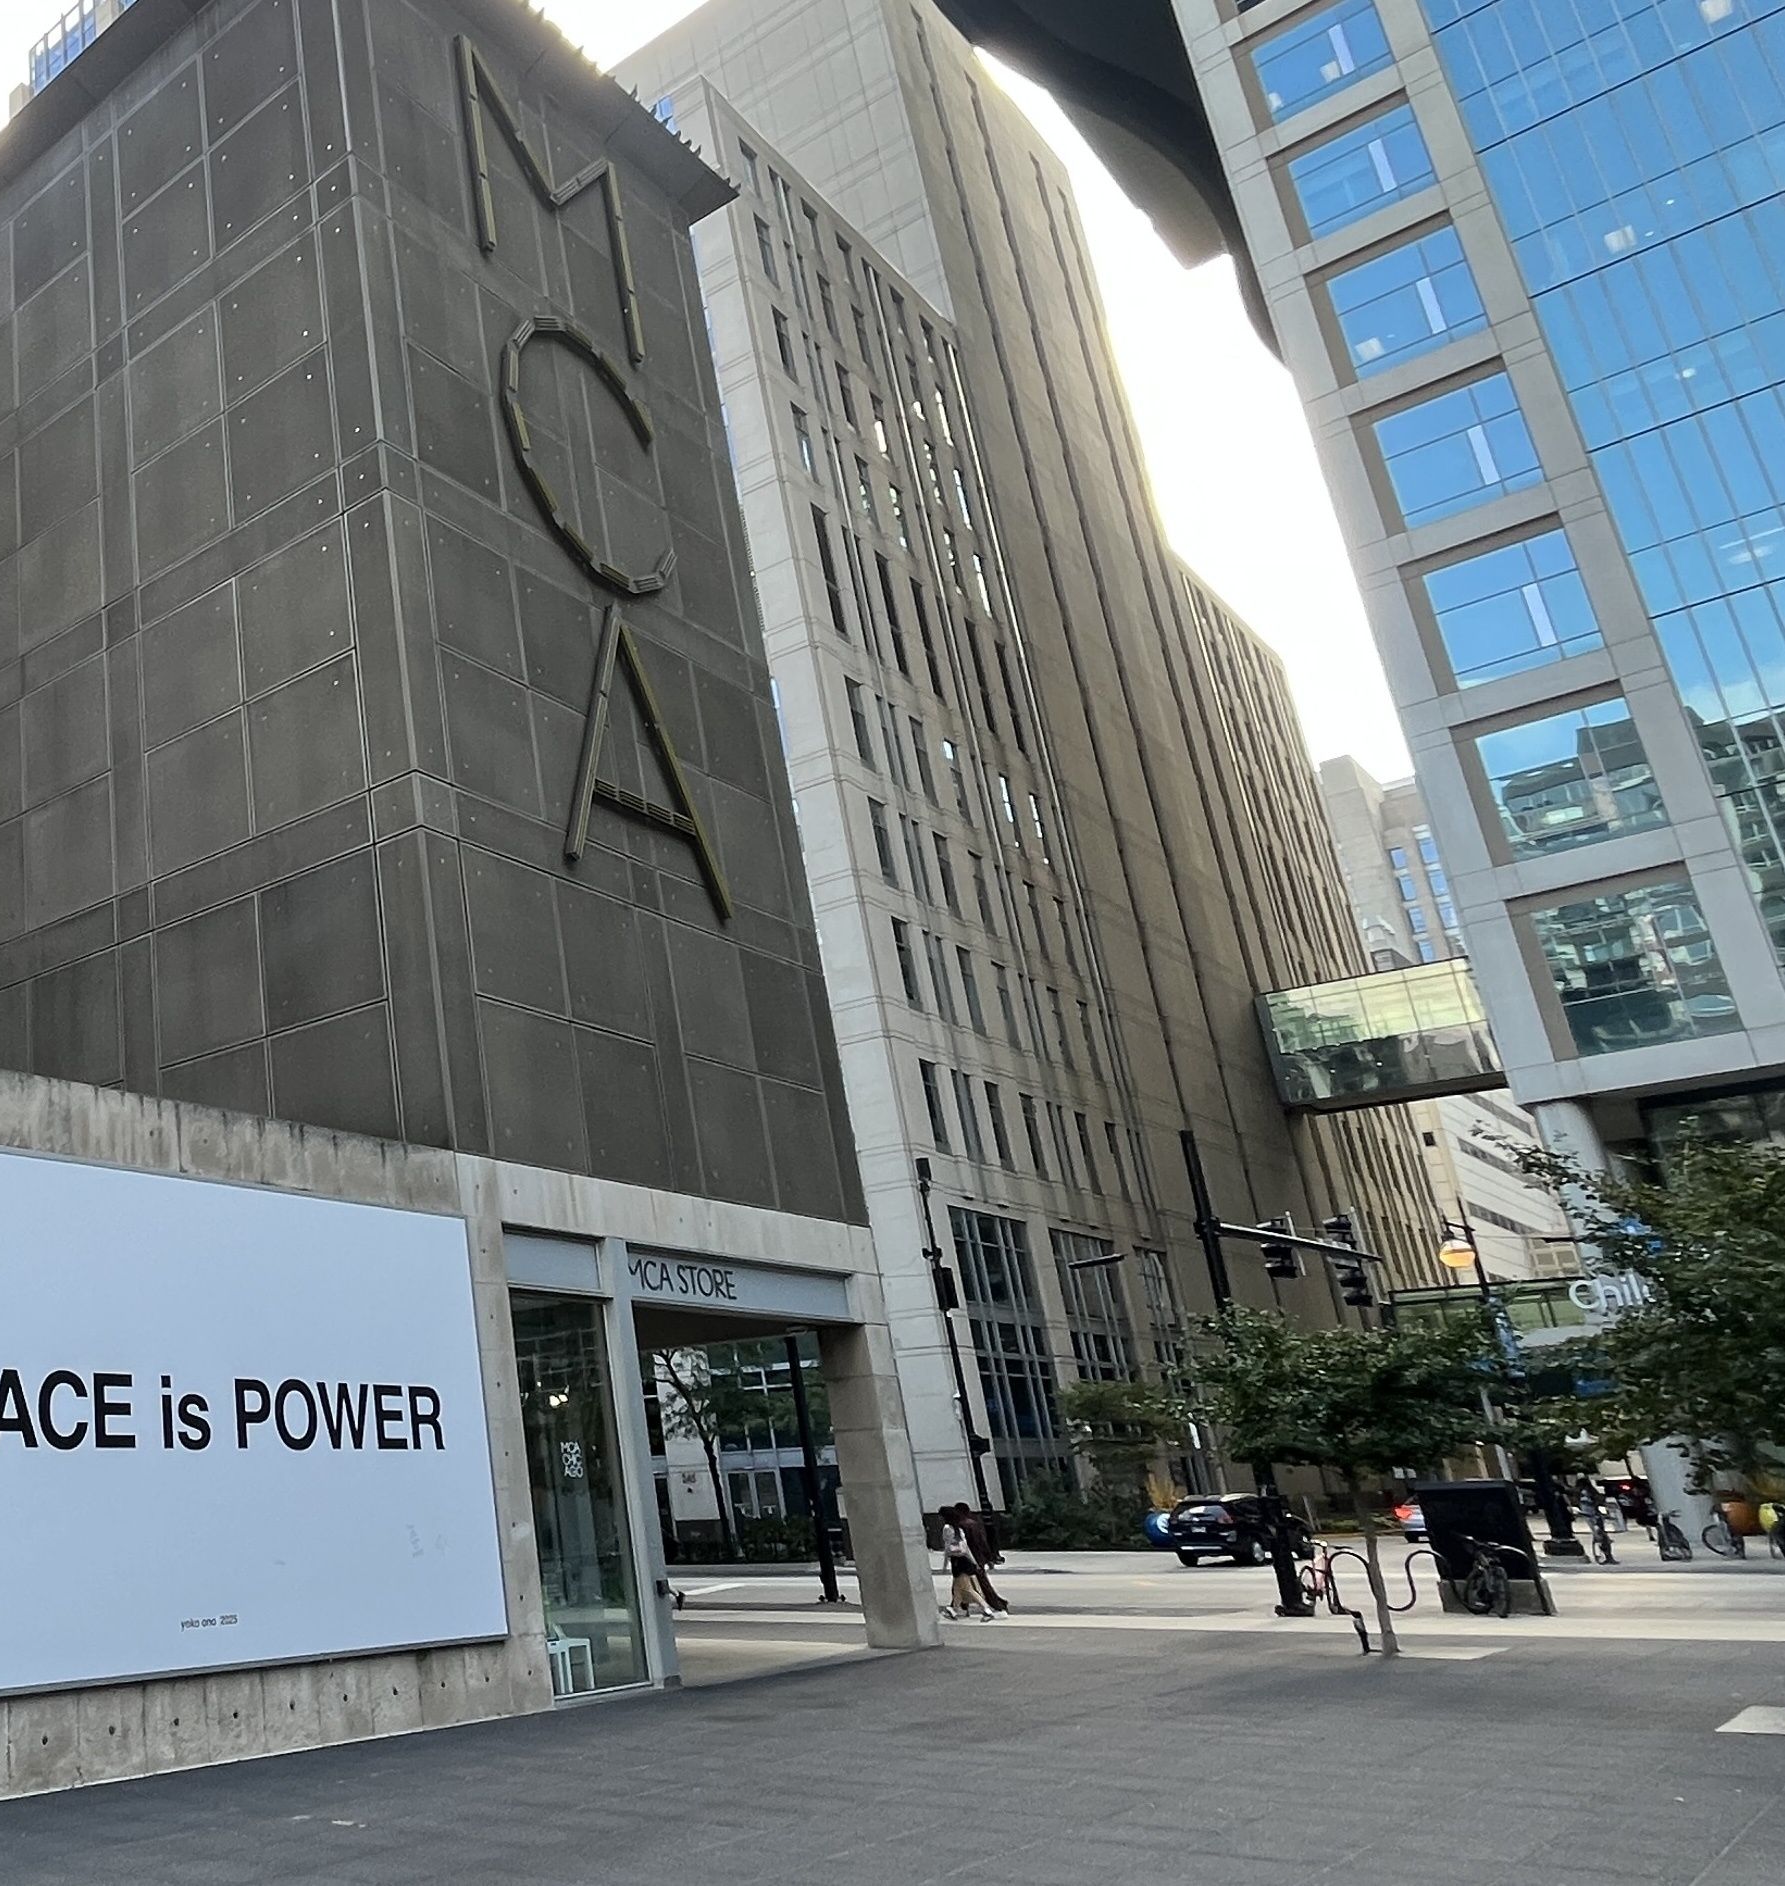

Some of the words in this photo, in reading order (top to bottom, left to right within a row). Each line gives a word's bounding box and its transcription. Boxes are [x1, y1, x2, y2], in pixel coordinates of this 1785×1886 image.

[452, 33, 733, 919] MCA
[676, 1264, 737, 1300] STORE
[161, 1375, 211, 1451] is
[234, 1378, 446, 1451] POWER
[560, 1441, 582, 1453] MCA
[564, 1465, 584, 1478] AGO
